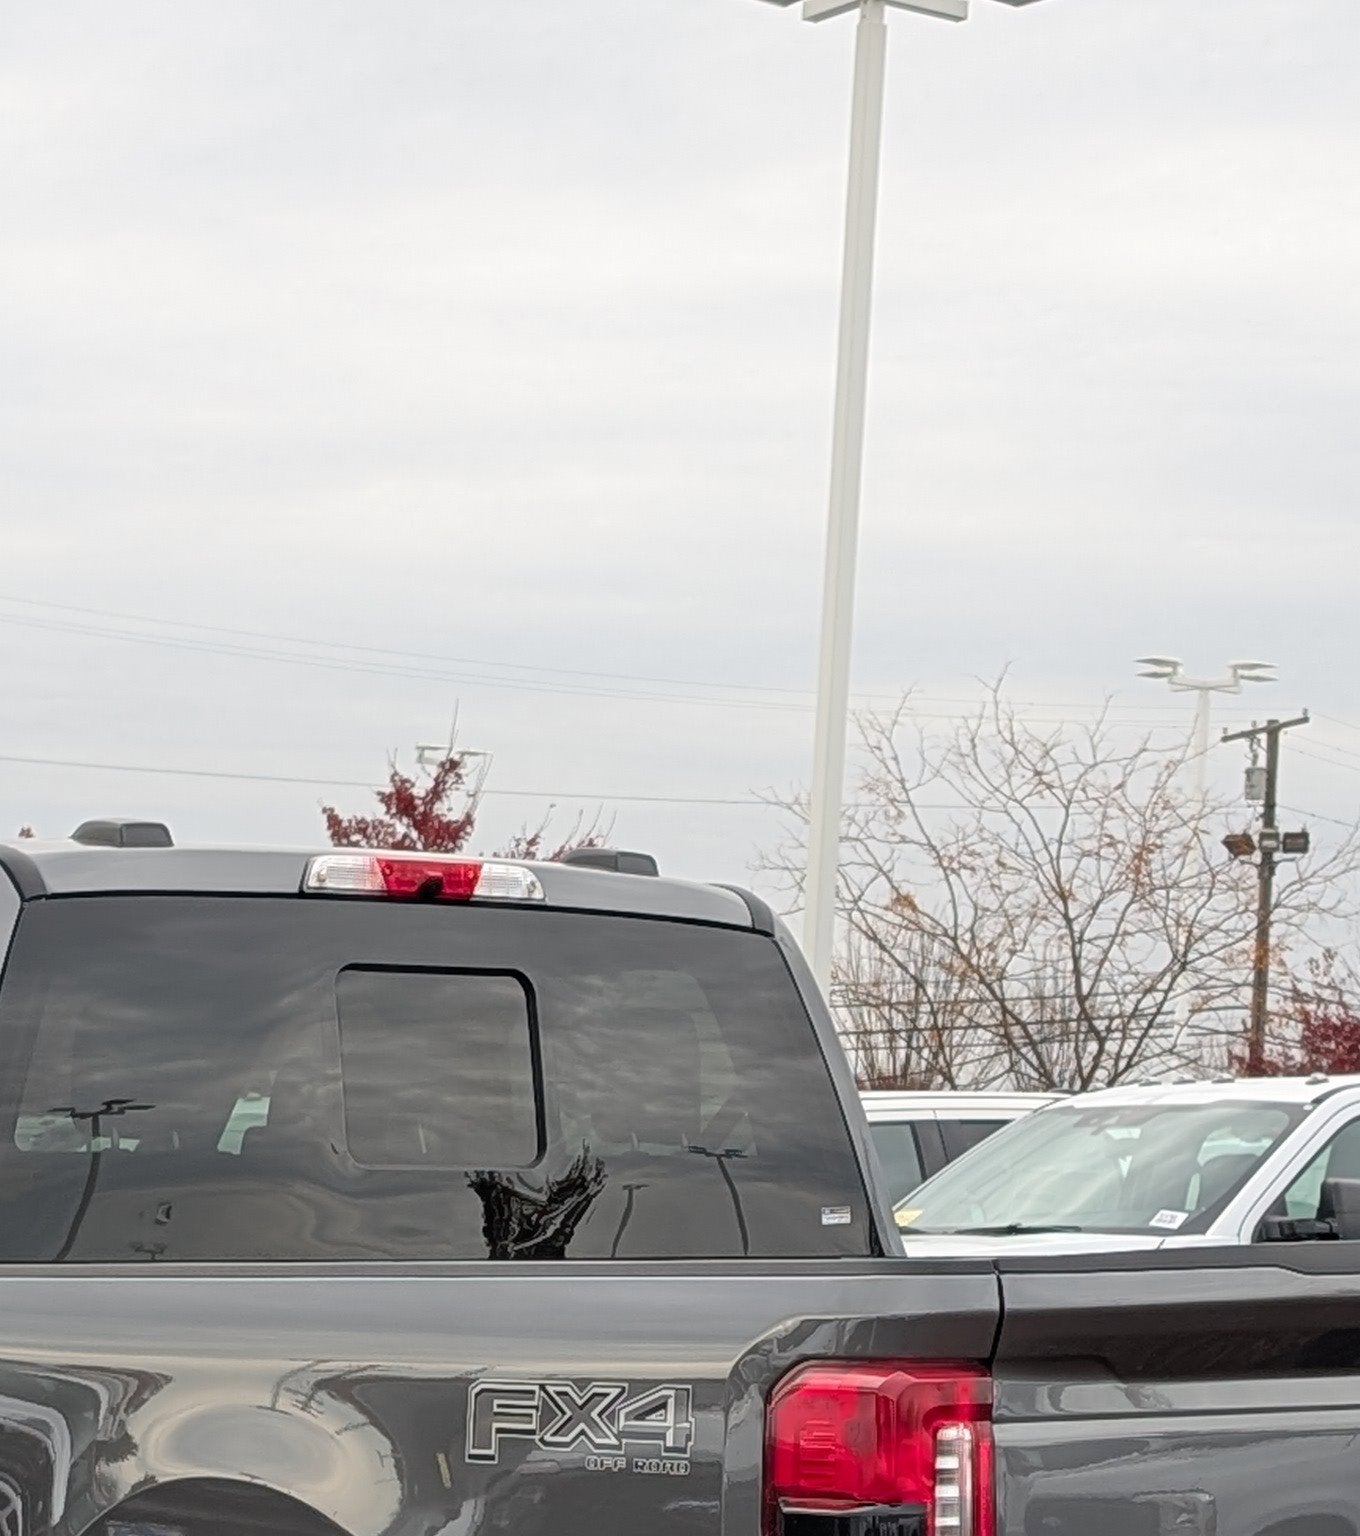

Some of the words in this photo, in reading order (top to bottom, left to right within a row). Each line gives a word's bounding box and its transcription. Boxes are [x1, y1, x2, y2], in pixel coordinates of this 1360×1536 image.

[465, 1379, 695, 1464] FX4
[585, 1455, 627, 1472] OFF
[632, 1457, 691, 1476] ROAD
